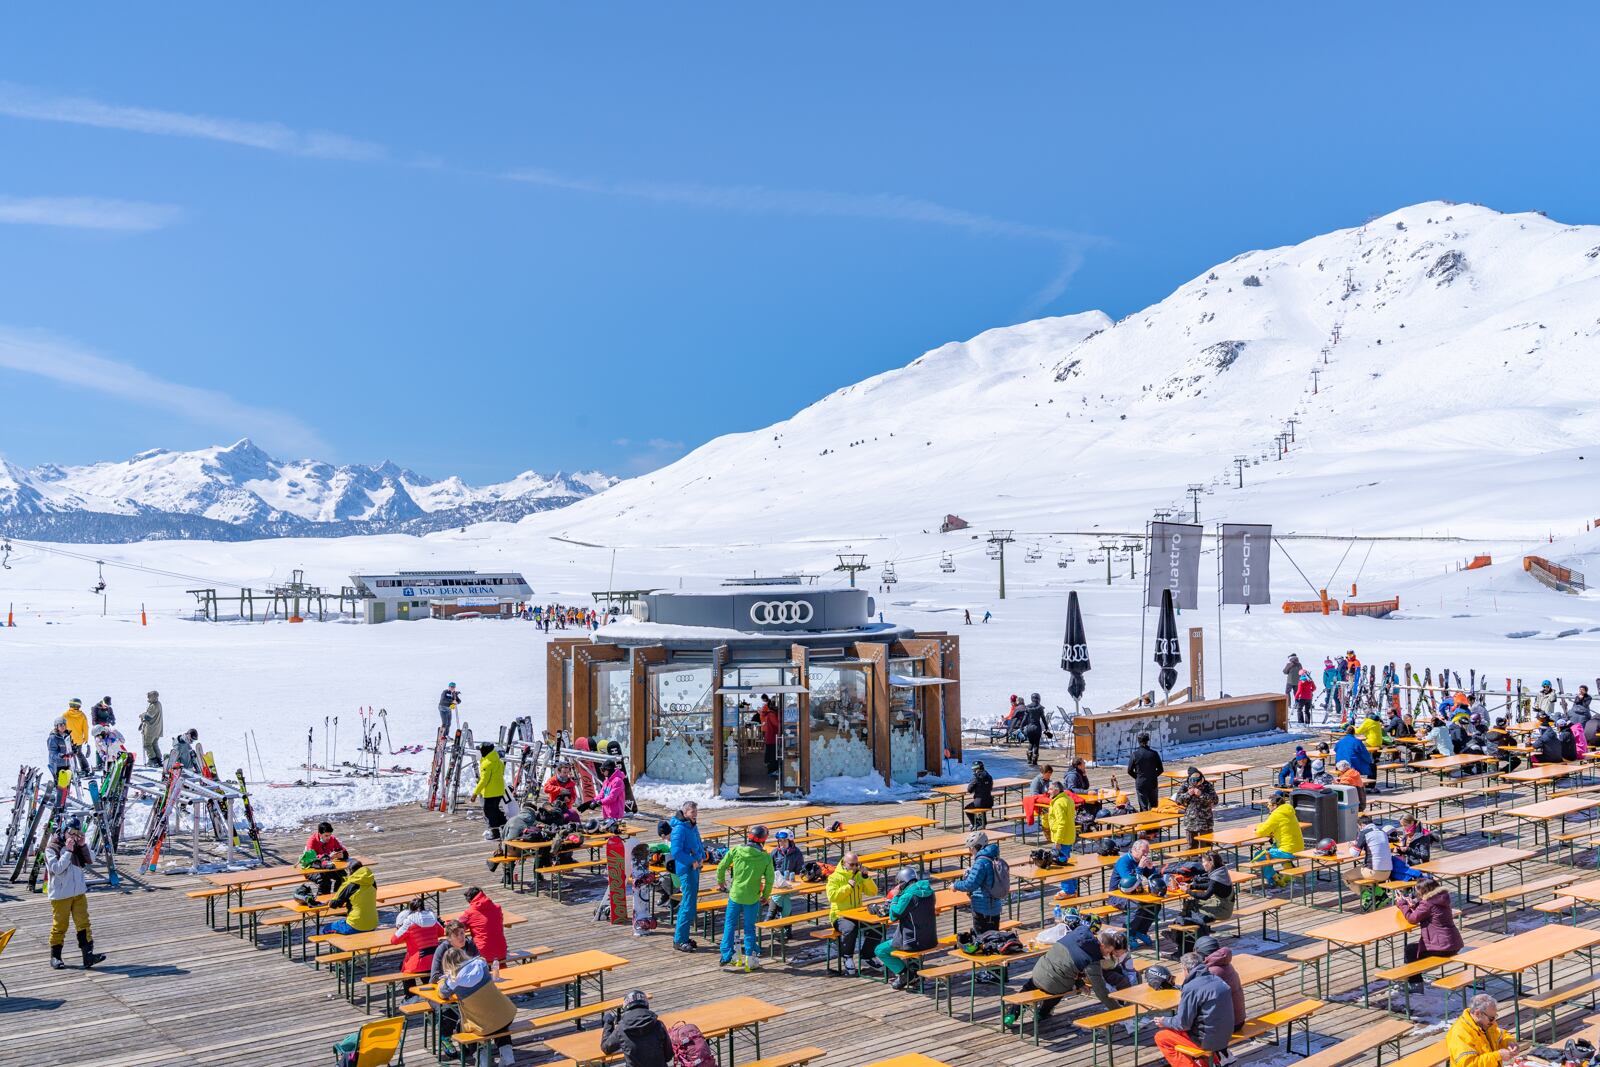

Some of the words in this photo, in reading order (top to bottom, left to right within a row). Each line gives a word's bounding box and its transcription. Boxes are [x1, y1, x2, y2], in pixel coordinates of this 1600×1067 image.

[1170, 533, 1182, 600] quattro
[1242, 533, 1250, 596] e-tron
[439, 587, 464, 595] DERA
[1188, 713, 1269, 736] quattro
